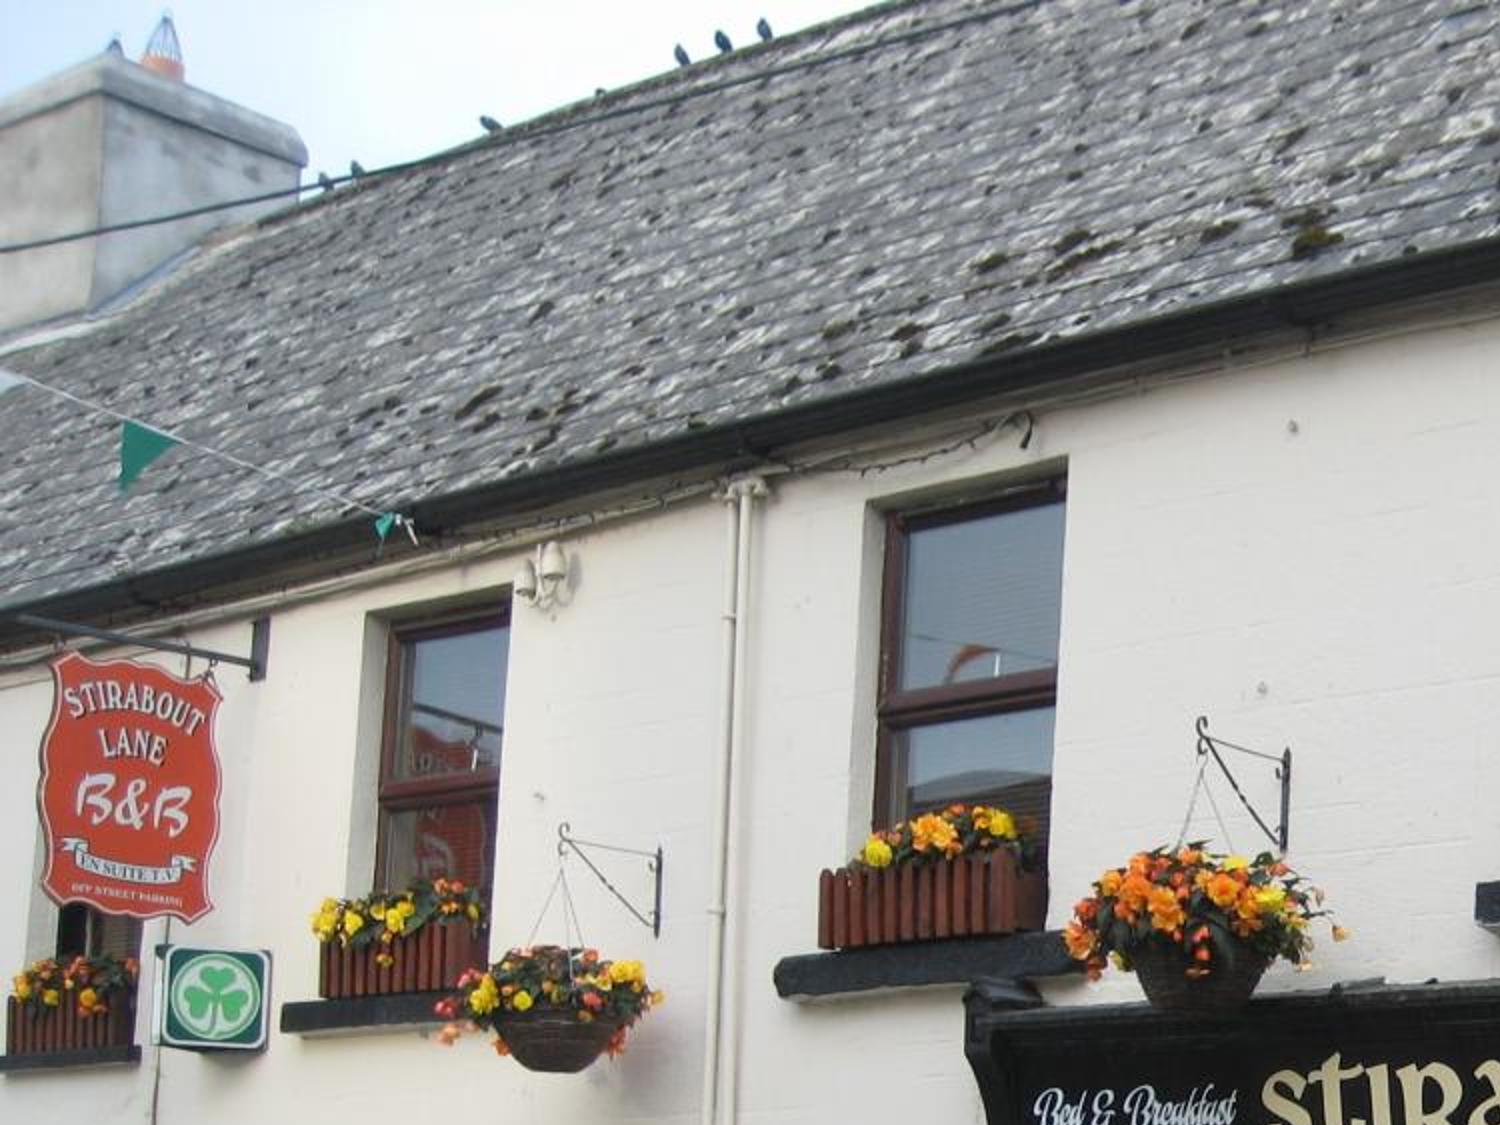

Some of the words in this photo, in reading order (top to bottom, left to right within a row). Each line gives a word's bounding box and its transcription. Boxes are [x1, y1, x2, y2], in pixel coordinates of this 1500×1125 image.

[64, 680, 205, 737] STIRABOUT
[99, 729, 168, 765] LANE
[75, 772, 192, 838] B&B
